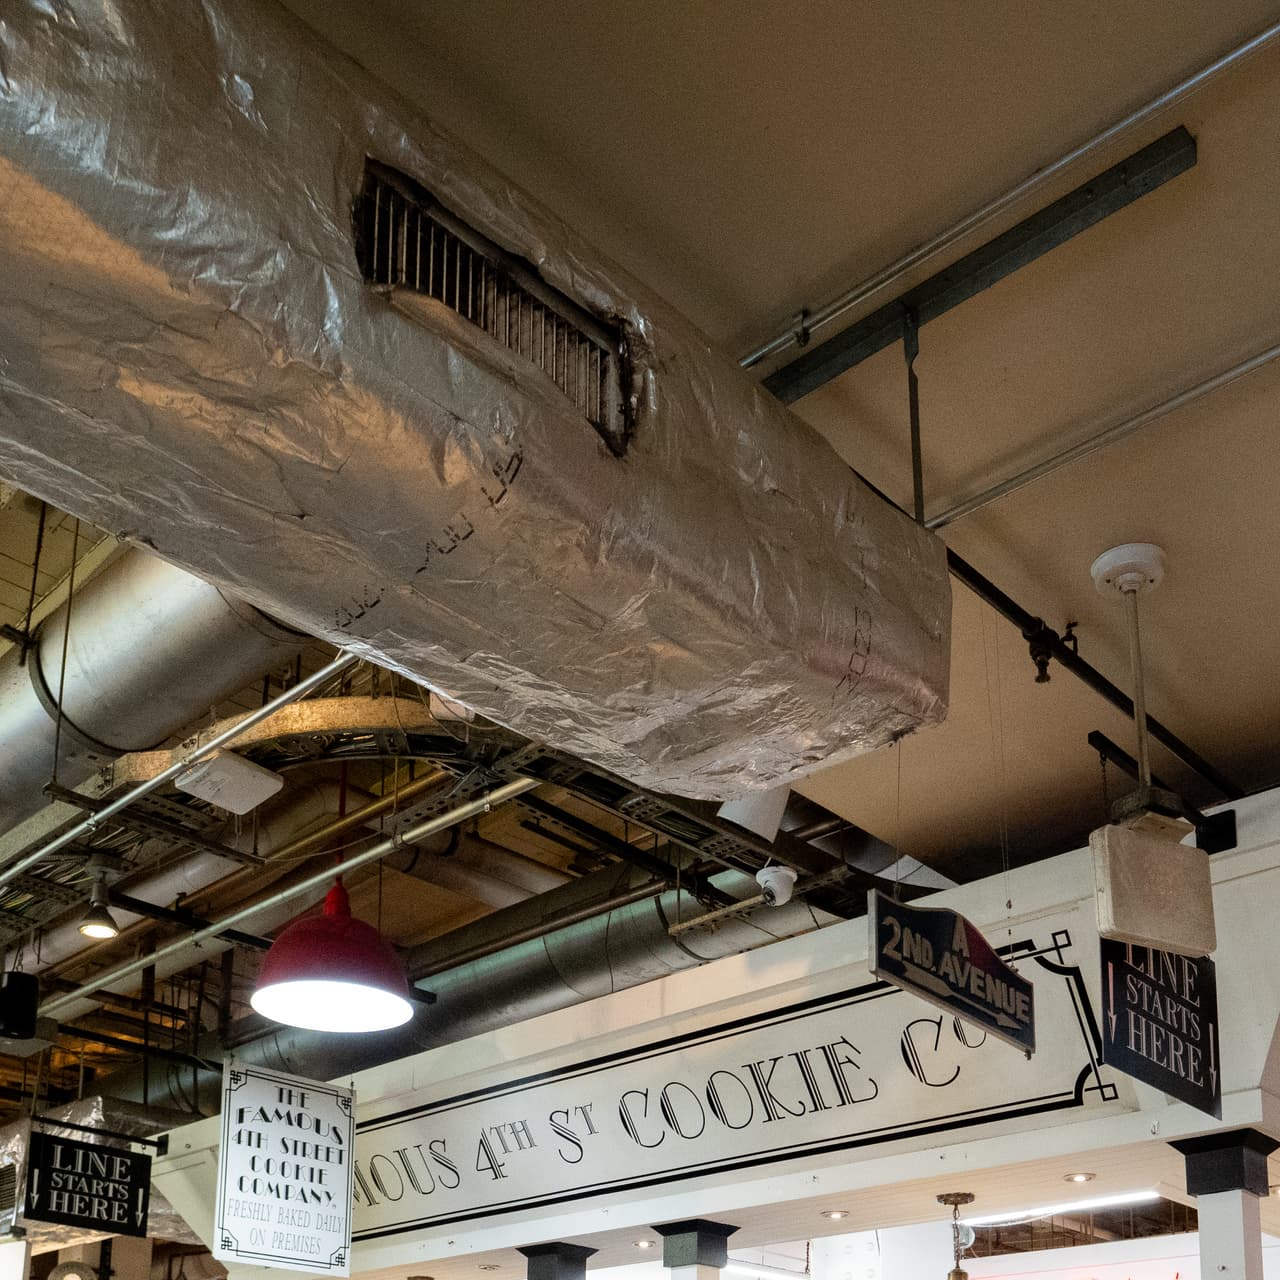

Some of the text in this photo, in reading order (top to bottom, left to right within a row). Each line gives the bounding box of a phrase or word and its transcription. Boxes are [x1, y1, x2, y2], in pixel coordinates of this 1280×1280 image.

[938, 951, 1032, 1024] AVENUE
[1123, 943, 1200, 1008] LINE
[1126, 974, 1201, 1041] STARTS
[1126, 1008, 1204, 1087] HERE
[275, 1086, 311, 1109] THE
[476, 1120, 538, 1181] 4TH
[549, 1102, 600, 1164] ST
[619, 1035, 879, 1148] COOKIE
[236, 1106, 344, 1146] FAMOUS
[49, 1144, 131, 1183] LINE
[232, 1128, 347, 1165] 4TH STREET
[51, 1172, 129, 1200] STARTS
[250, 1155, 329, 1185] COOKIE
[48, 1190, 129, 1224] HERE
[228, 1199, 345, 1234] FRESHLY BAKED DAILY
[250, 1227, 322, 1256] ON PREMISES
